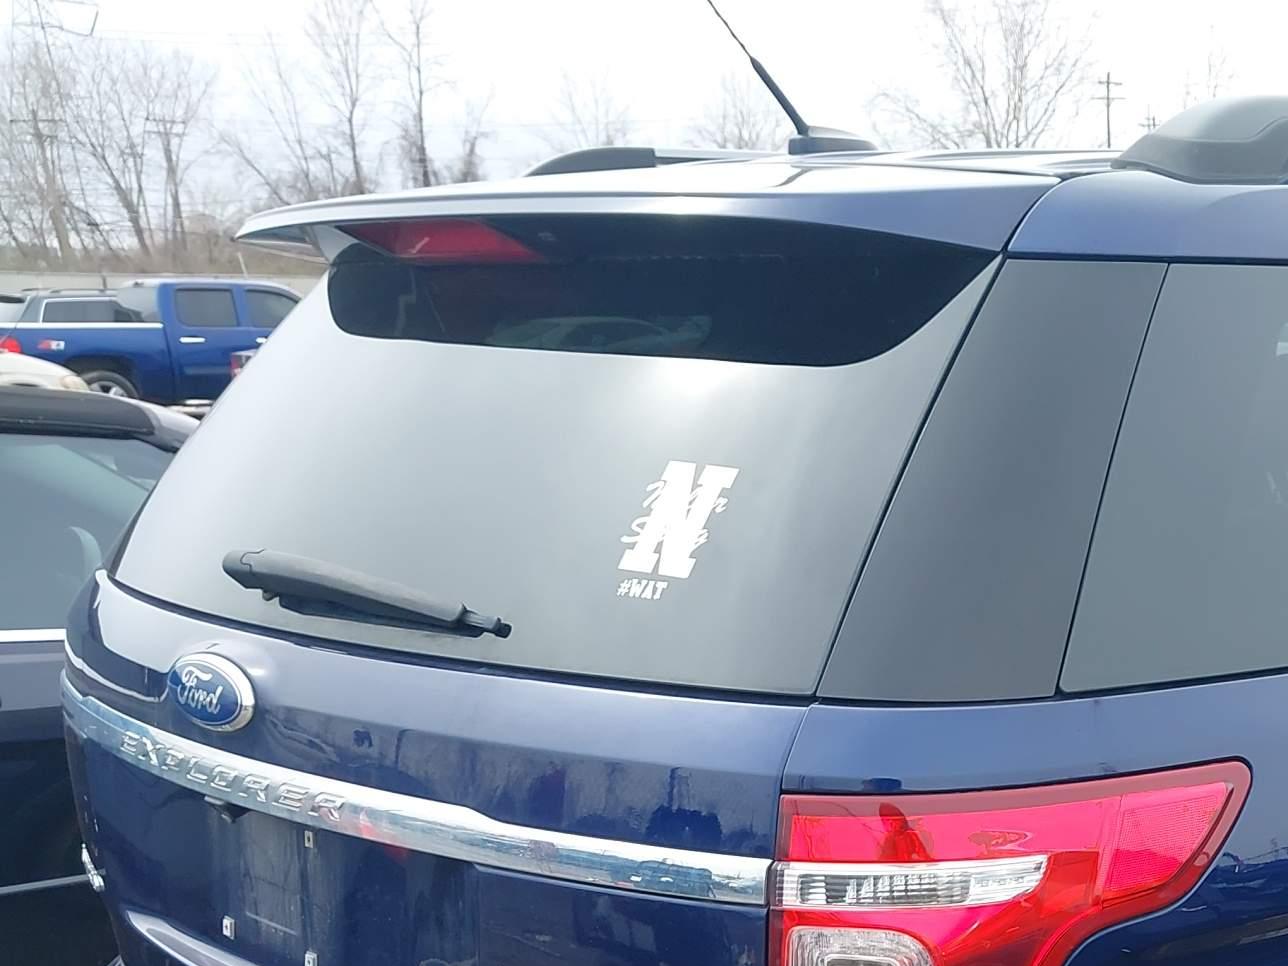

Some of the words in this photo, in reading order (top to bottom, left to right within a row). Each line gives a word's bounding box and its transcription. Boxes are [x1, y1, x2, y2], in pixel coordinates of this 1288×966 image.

[616, 578, 669, 600] #WAT
[177, 665, 222, 715] Ford
[119, 731, 345, 822] EXPLORER
